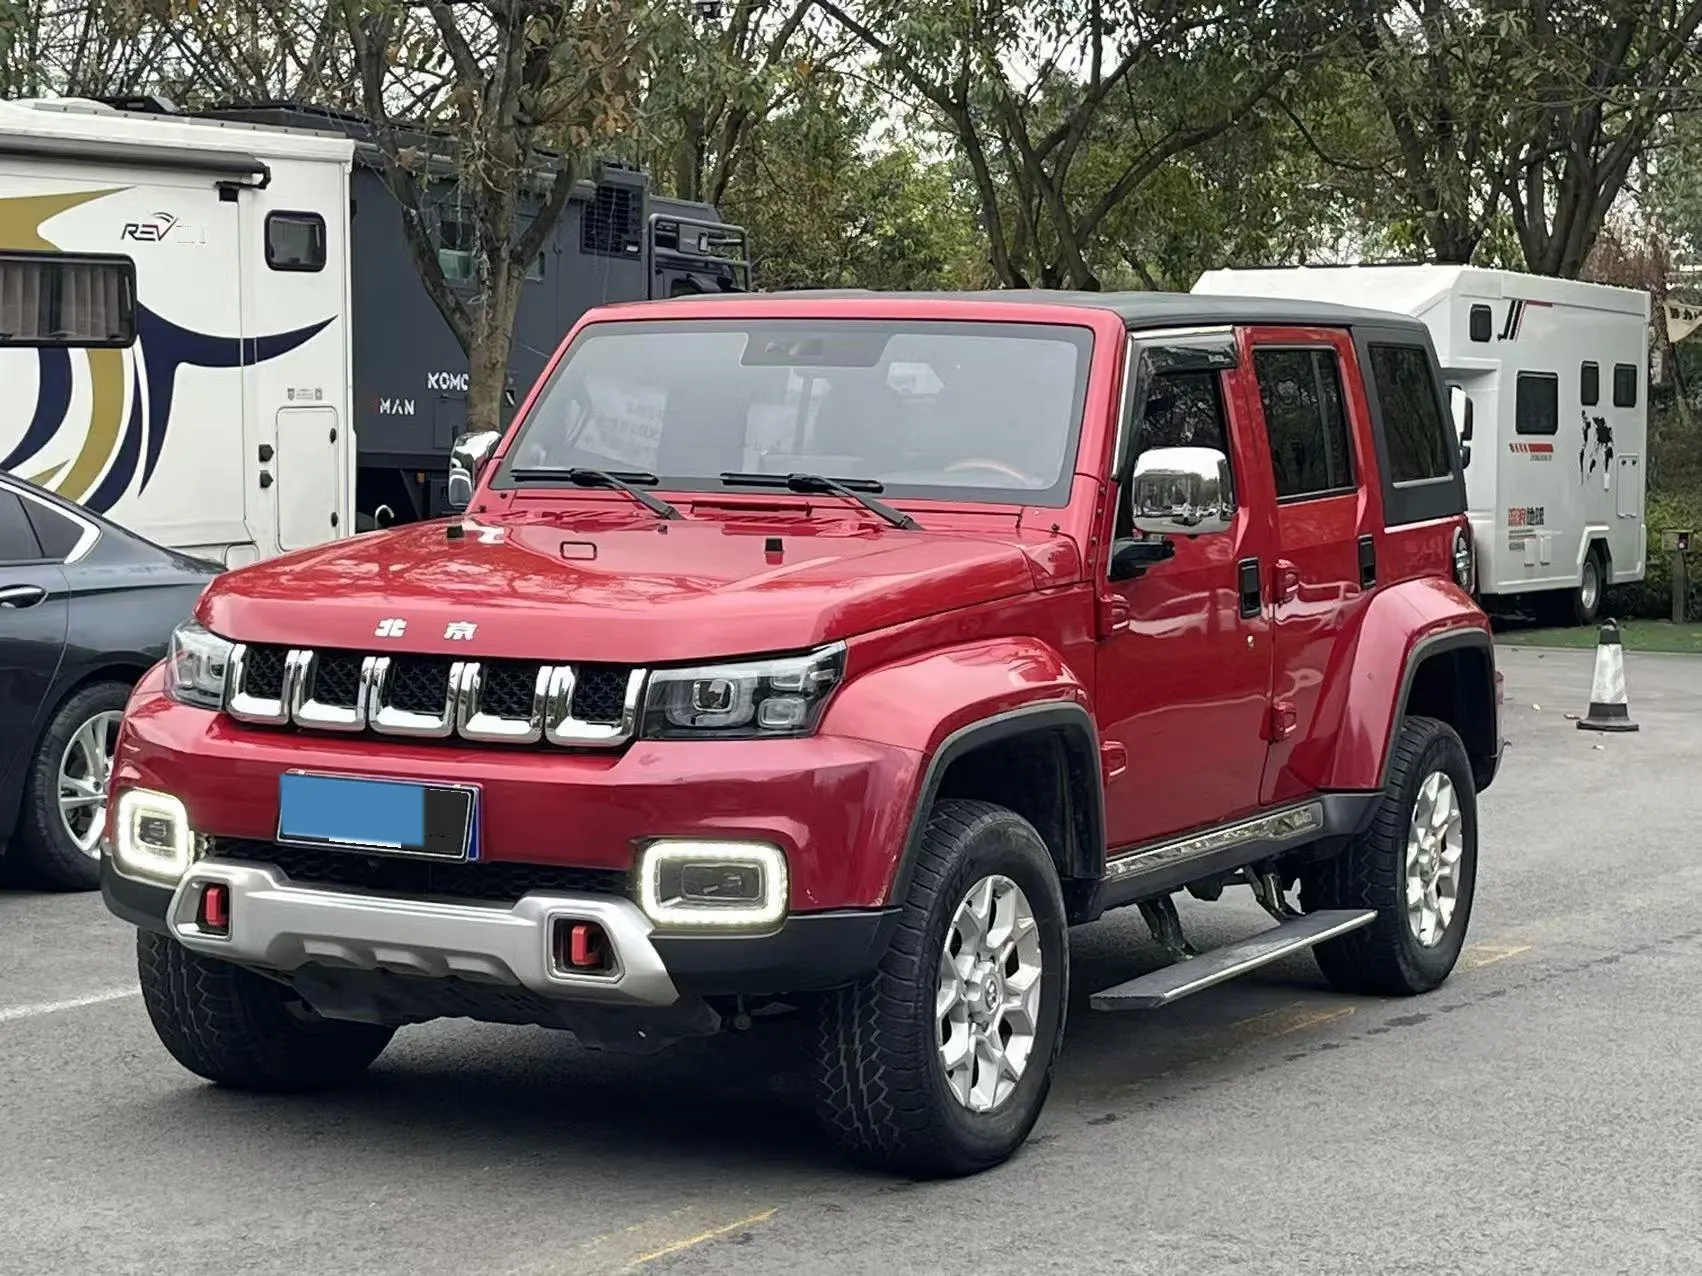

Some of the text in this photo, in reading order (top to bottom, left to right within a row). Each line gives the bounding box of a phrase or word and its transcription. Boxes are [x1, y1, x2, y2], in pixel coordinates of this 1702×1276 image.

[120, 215, 179, 242] REV
[379, 397, 415, 416] MAN
[374, 618, 478, 641] 北京
